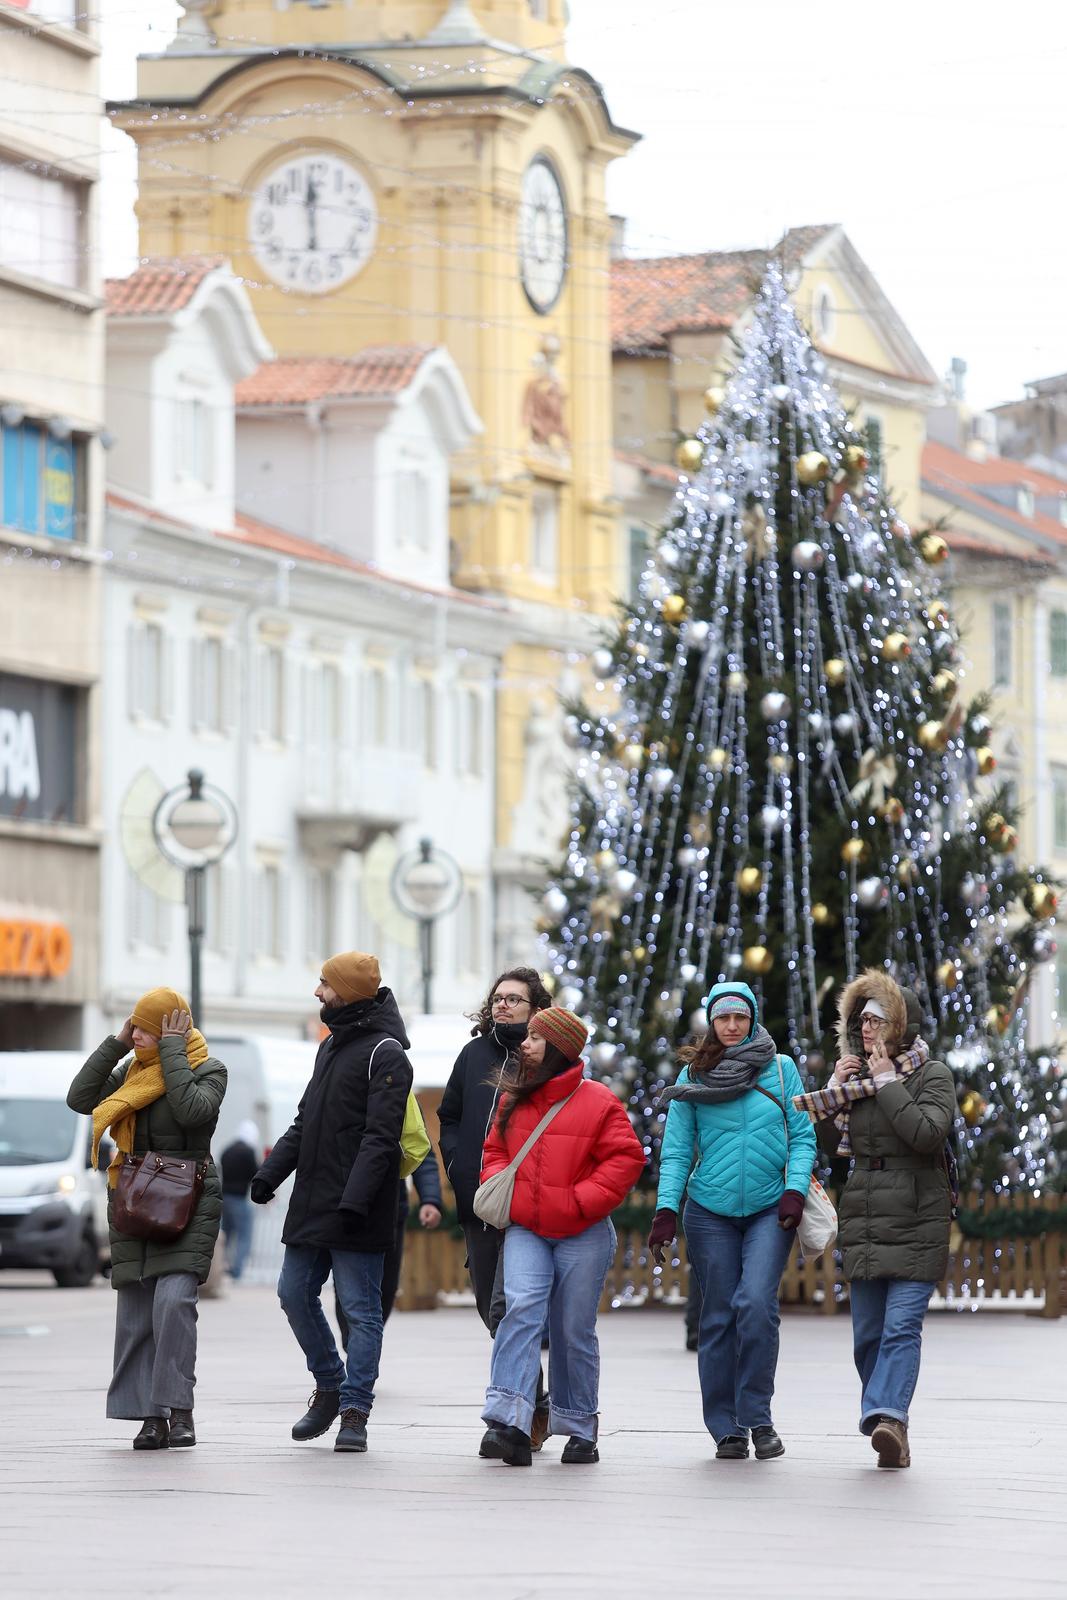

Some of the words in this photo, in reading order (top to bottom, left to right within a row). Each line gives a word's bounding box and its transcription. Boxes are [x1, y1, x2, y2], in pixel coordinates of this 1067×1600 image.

[306, 161, 329, 188] 12
[334, 168, 344, 194] 1
[303, 257, 323, 284] 6
